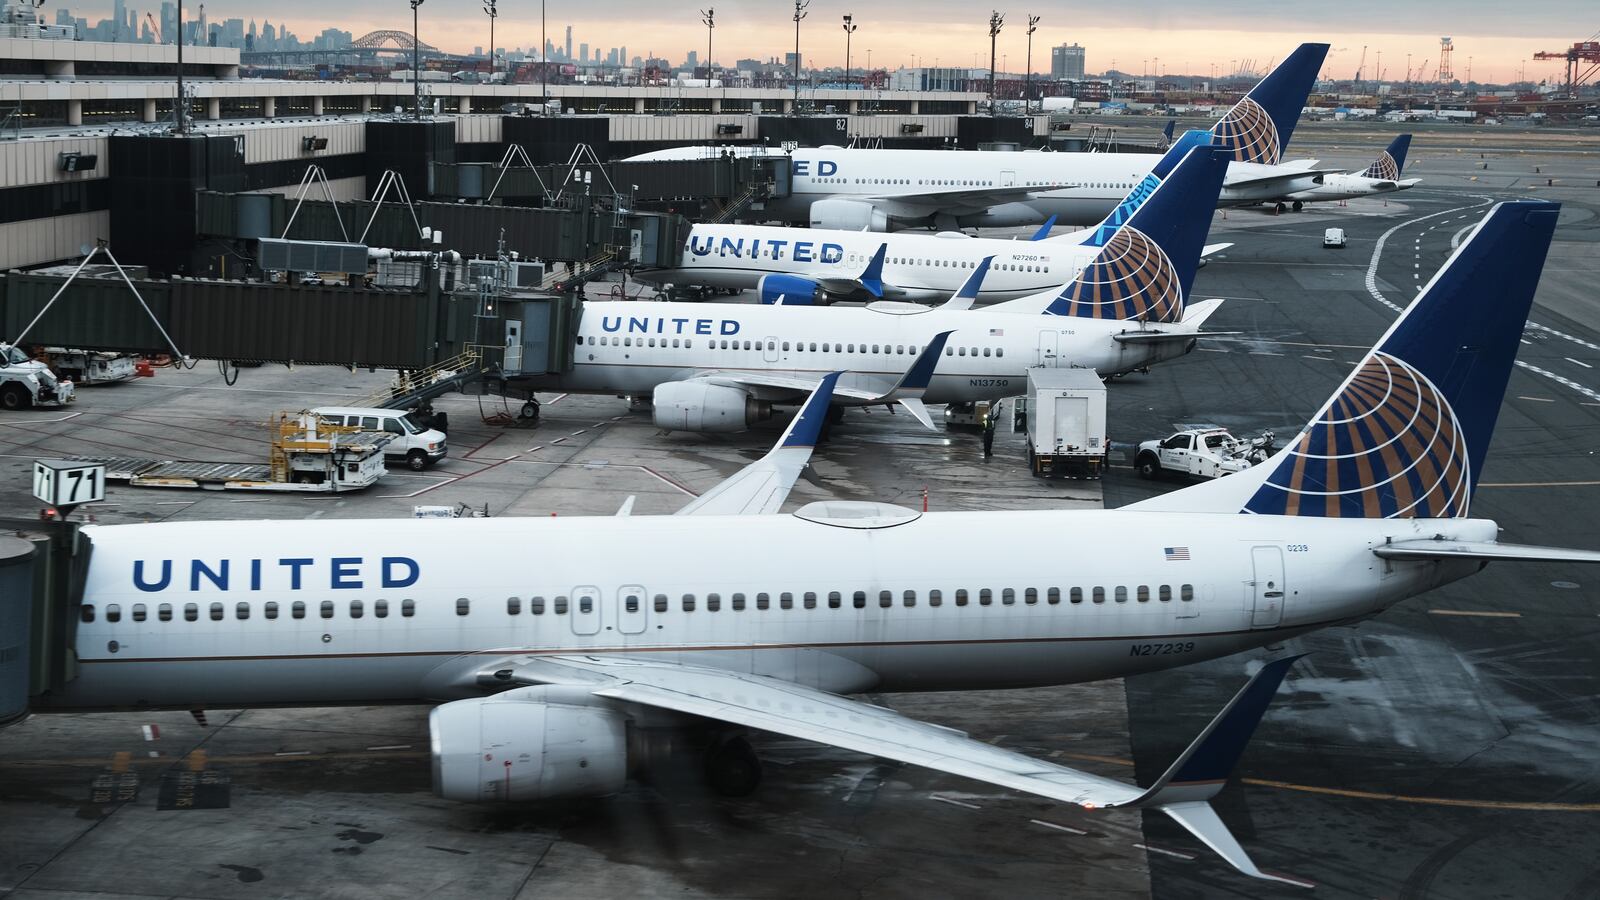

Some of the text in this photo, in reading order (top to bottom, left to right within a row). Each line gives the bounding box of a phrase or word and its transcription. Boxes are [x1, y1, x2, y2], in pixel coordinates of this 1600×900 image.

[836, 119, 846, 130] 82
[1024, 118, 1033, 129] 84
[233, 137, 244, 156] 74
[690, 235, 844, 264] UNITED
[1012, 254, 1038, 262] N27260
[602, 316, 741, 336] UNITED
[969, 379, 1009, 387] N13750
[67, 468, 97, 502] 71
[132, 556, 421, 592] UNITED
[1129, 641, 1194, 656] N27239
